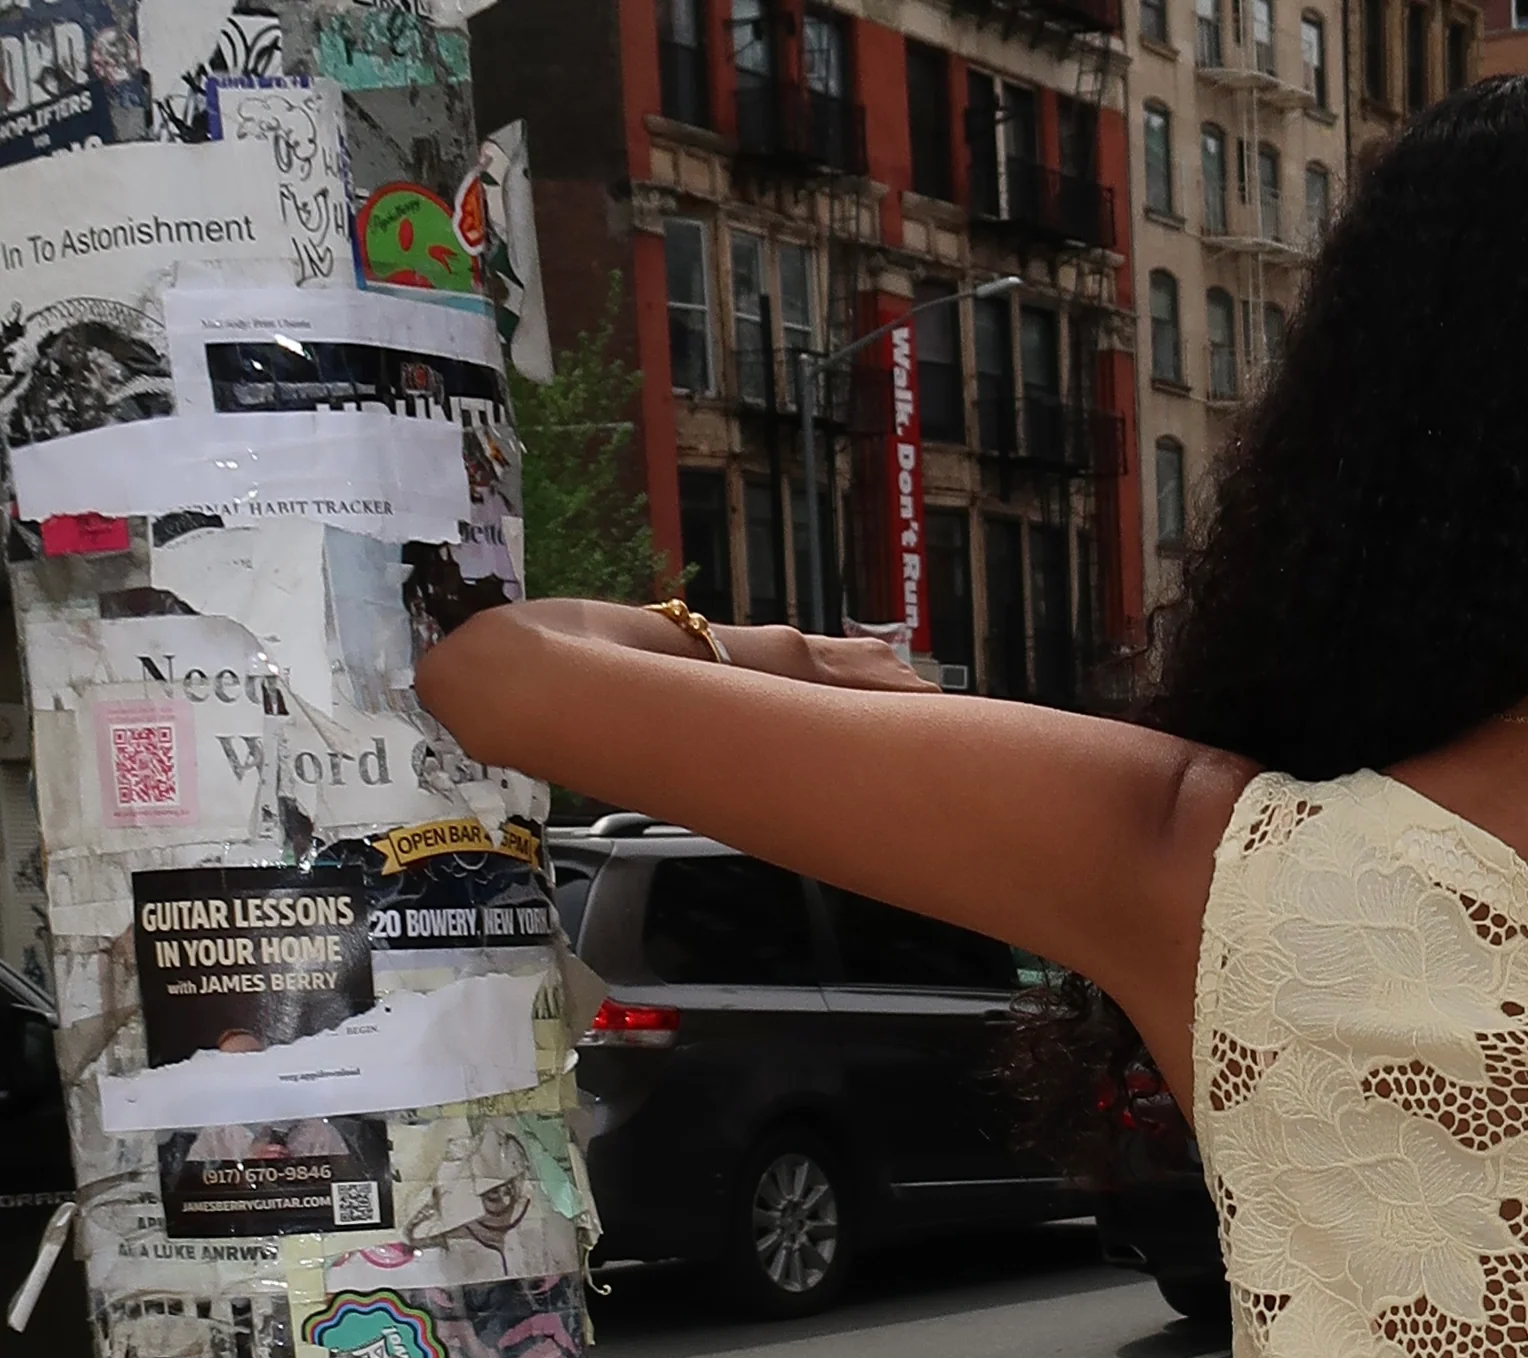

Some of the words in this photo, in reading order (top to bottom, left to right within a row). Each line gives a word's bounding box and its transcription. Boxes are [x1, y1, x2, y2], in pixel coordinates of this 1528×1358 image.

[27, 235, 55, 264] To
[61, 214, 256, 259] Astonishment
[250, 500, 308, 518] HABIT
[315, 498, 395, 518] TRACKER
[396, 831, 447, 856] OPEN
[448, 824, 483, 844] BAR
[141, 899, 230, 933] GUITAR
[231, 894, 355, 930] LESSONS
[154, 939, 181, 969] IN
[183, 935, 256, 968] YOUR
[259, 934, 343, 967] HOME
[167, 976, 198, 995] with
[199, 973, 267, 994] JAMES
[271, 969, 339, 992] BERRY
[202, 1168, 241, 1186] (917)
[245, 1163, 332, 1183] 670-9846
[182, 1195, 332, 1214] JAMESBERRYGUITAR.COM
